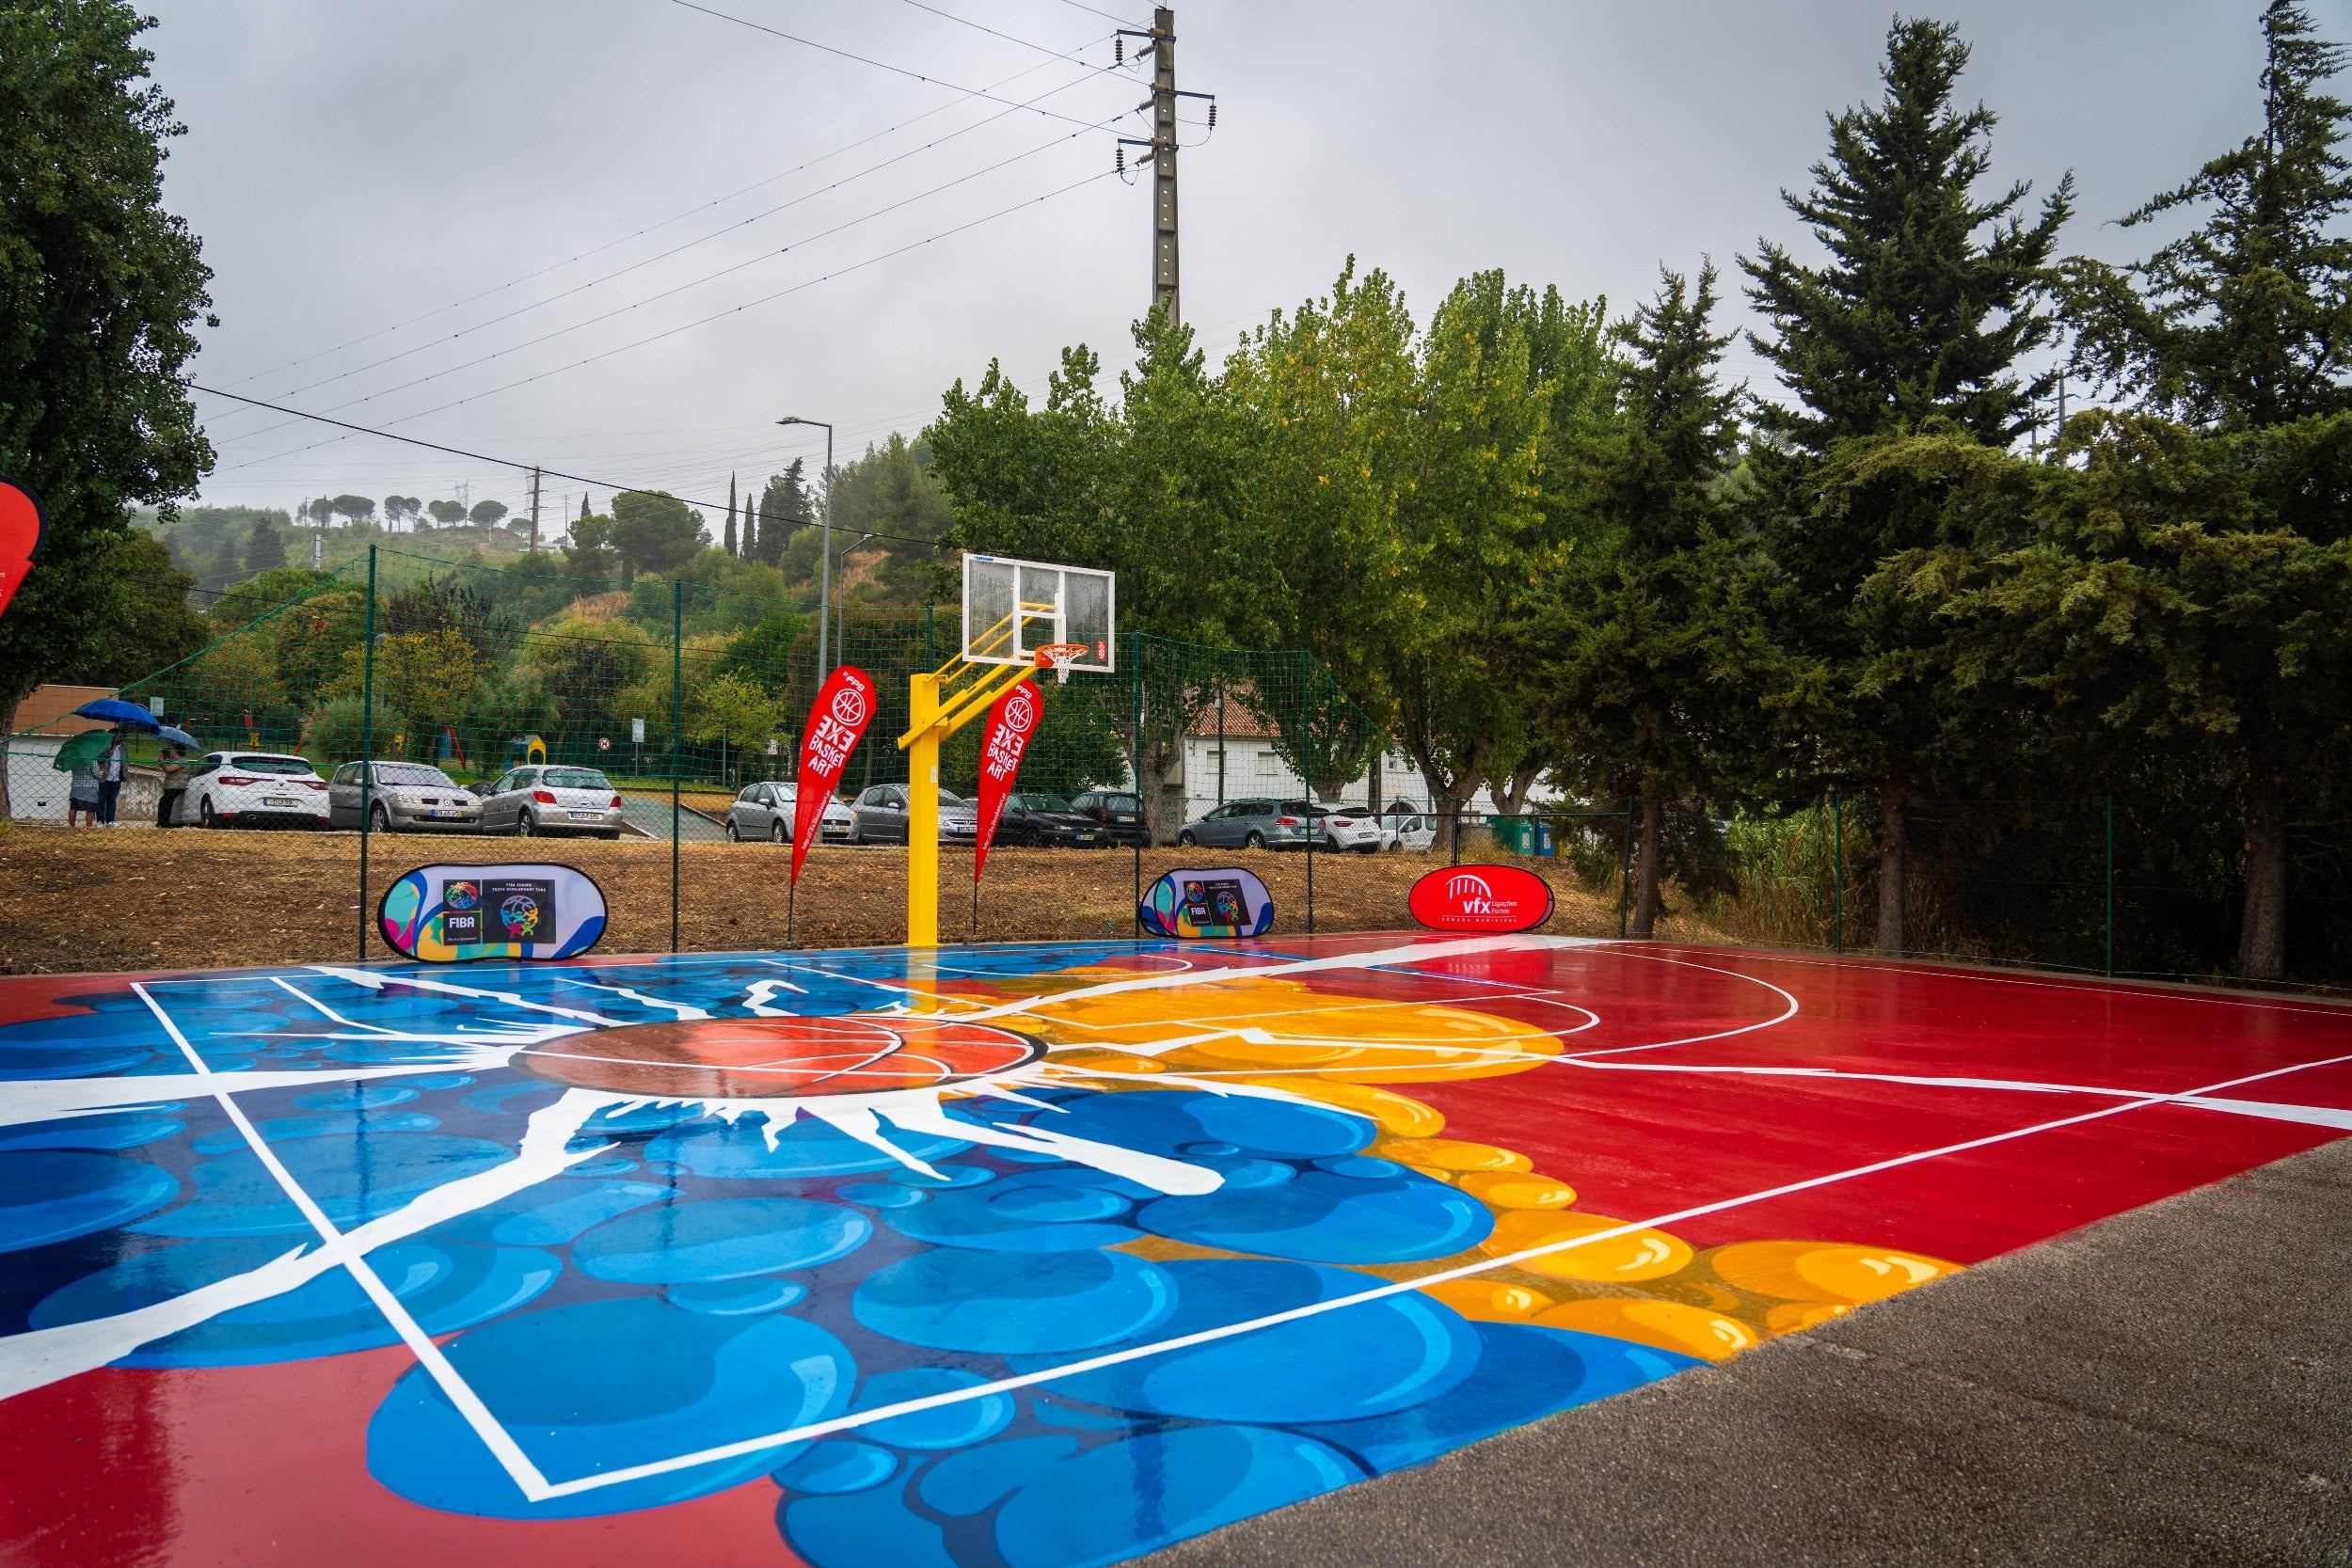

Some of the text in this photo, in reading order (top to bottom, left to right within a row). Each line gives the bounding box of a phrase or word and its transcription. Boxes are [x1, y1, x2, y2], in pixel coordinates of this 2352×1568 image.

[846, 675, 865, 691] FPB
[808, 734, 847, 768] BASKET
[987, 741, 1019, 771] BASKET
[808, 755, 834, 778] ART
[986, 761, 1008, 782] ART
[1191, 907, 1206, 915] FIBA
[1463, 897, 1491, 913] vfx
[449, 917, 474, 928] FIBA
